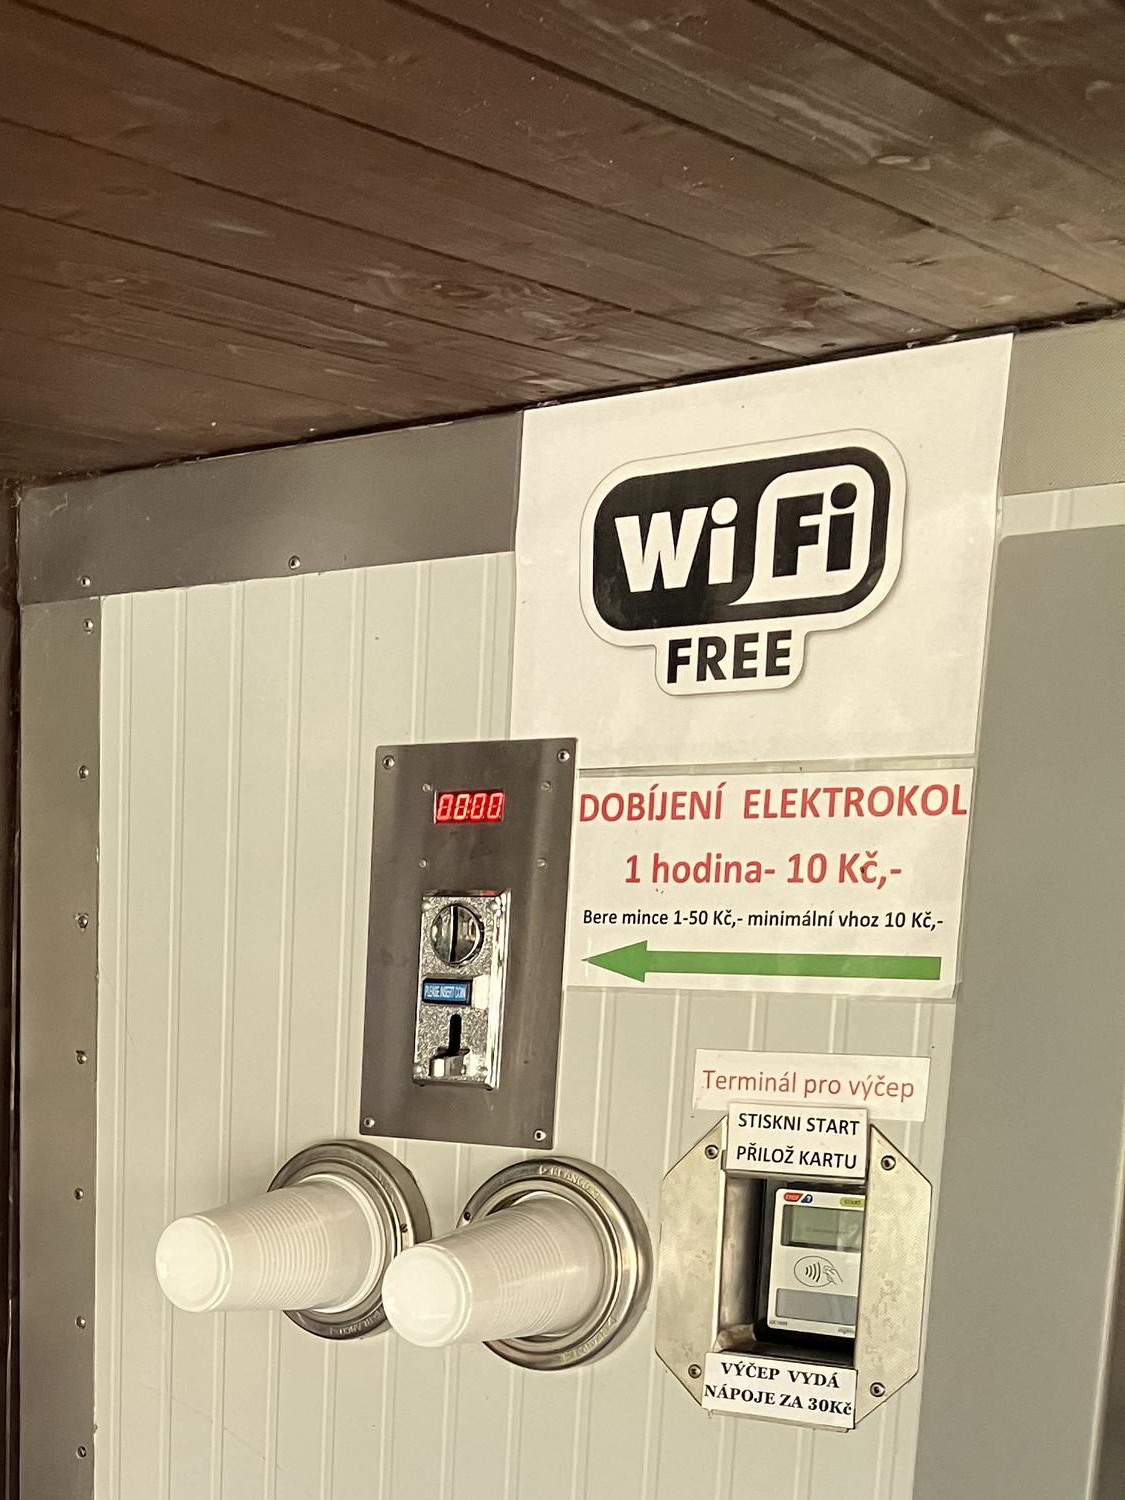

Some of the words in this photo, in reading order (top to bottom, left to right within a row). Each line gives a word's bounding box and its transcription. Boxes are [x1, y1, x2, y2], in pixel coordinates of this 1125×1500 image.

[666, 630, 792, 684] FREE
[579, 782, 727, 822] DOBÍJENÍ
[742, 784, 968, 820] ELEKTROKOL
[625, 854, 640, 884] 1
[652, 852, 775, 884] hodina-
[787, 853, 827, 884] 10
[838, 850, 902, 890] Kč,-
[582, 909, 618, 925] Bere
[622, 909, 669, 926] mince
[673, 910, 708, 926] 1-50
[713, 909, 744, 929] Kč,-
[747, 910, 833, 928] minimální
[838, 911, 879, 928] vhoz
[884, 911, 906, 928] 10
[911, 910, 944, 932] Kč,-
[702, 1069, 796, 1093] Terminál
[804, 1078, 841, 1098] pro
[849, 1074, 915, 1103] výčep
[738, 1112, 801, 1131] STISKNI
[806, 1117, 860, 1136] START
[736, 1142, 794, 1165] PŘILOŽ
[799, 1150, 857, 1170] KARTU
[721, 1361, 780, 1381] VÝČEP
[787, 1370, 841, 1388] VYDÁ
[704, 1383, 776, 1405] NÁPOJE
[779, 1393, 804, 1409] ZA
[808, 1397, 852, 1416] 30Kč
